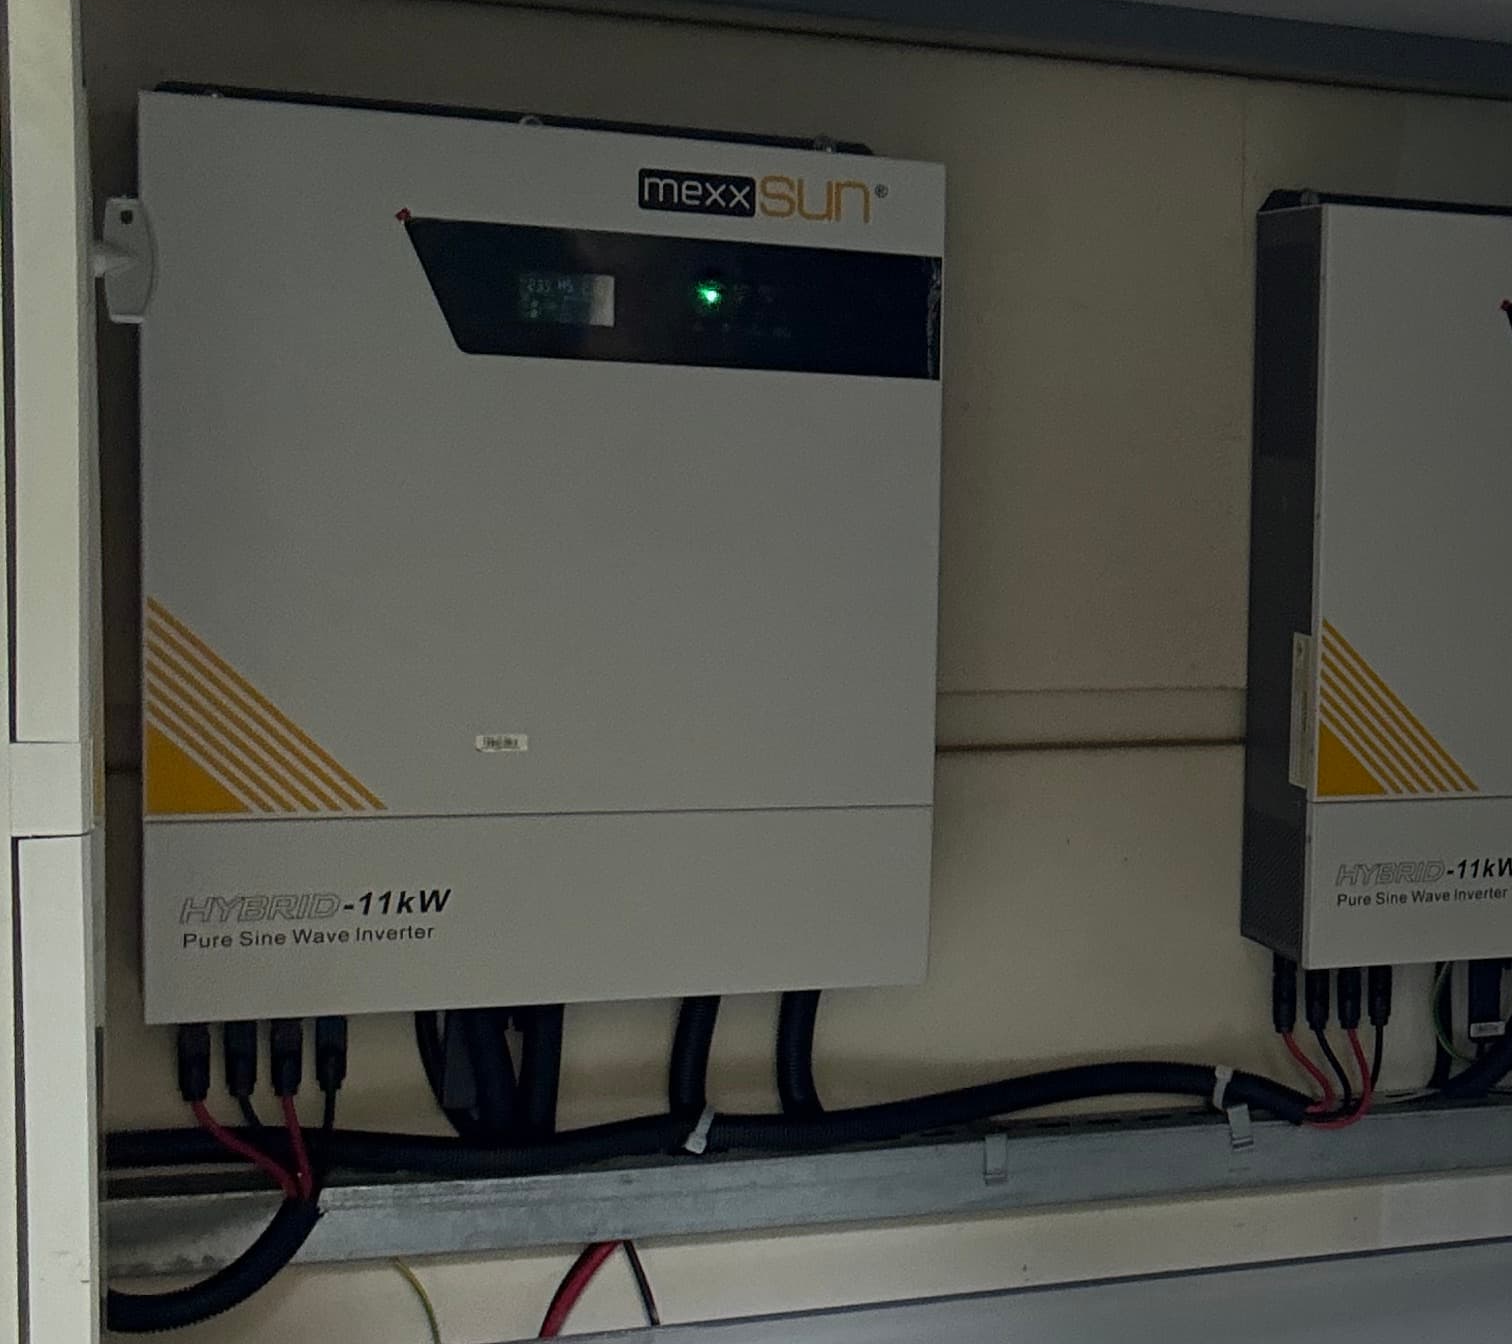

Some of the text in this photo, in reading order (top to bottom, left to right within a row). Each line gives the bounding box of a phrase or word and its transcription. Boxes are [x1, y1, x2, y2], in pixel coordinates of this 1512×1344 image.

[1337, 886, 1508, 906] Pure Sine Wave Inverter
[182, 924, 435, 949] Pure Sine Wave Inverter
